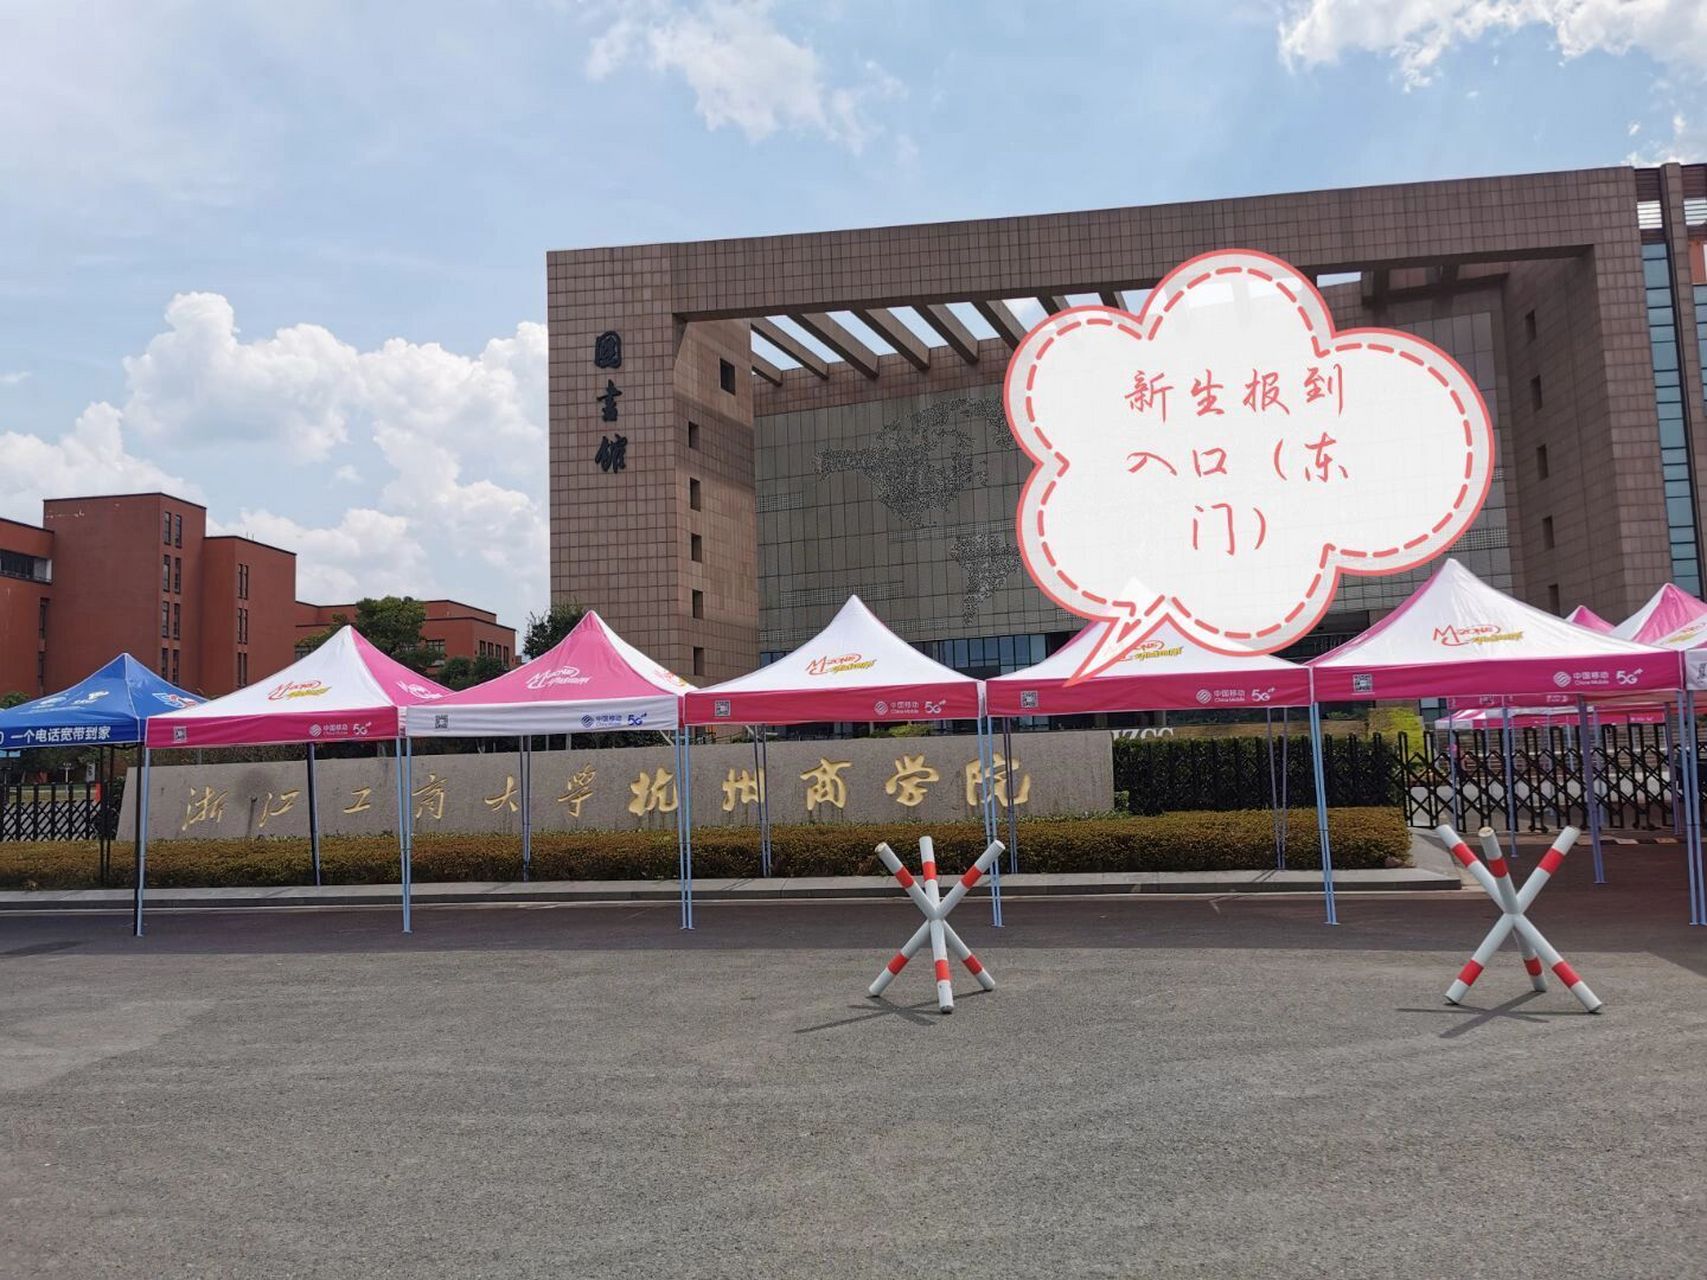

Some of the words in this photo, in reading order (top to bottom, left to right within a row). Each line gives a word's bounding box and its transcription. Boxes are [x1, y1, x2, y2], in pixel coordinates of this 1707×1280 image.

[1573, 672, 1610, 681] 中国移动
[1214, 690, 1246, 698] 中国移动
[11, 726, 111, 744] 一个电话宽带到家
